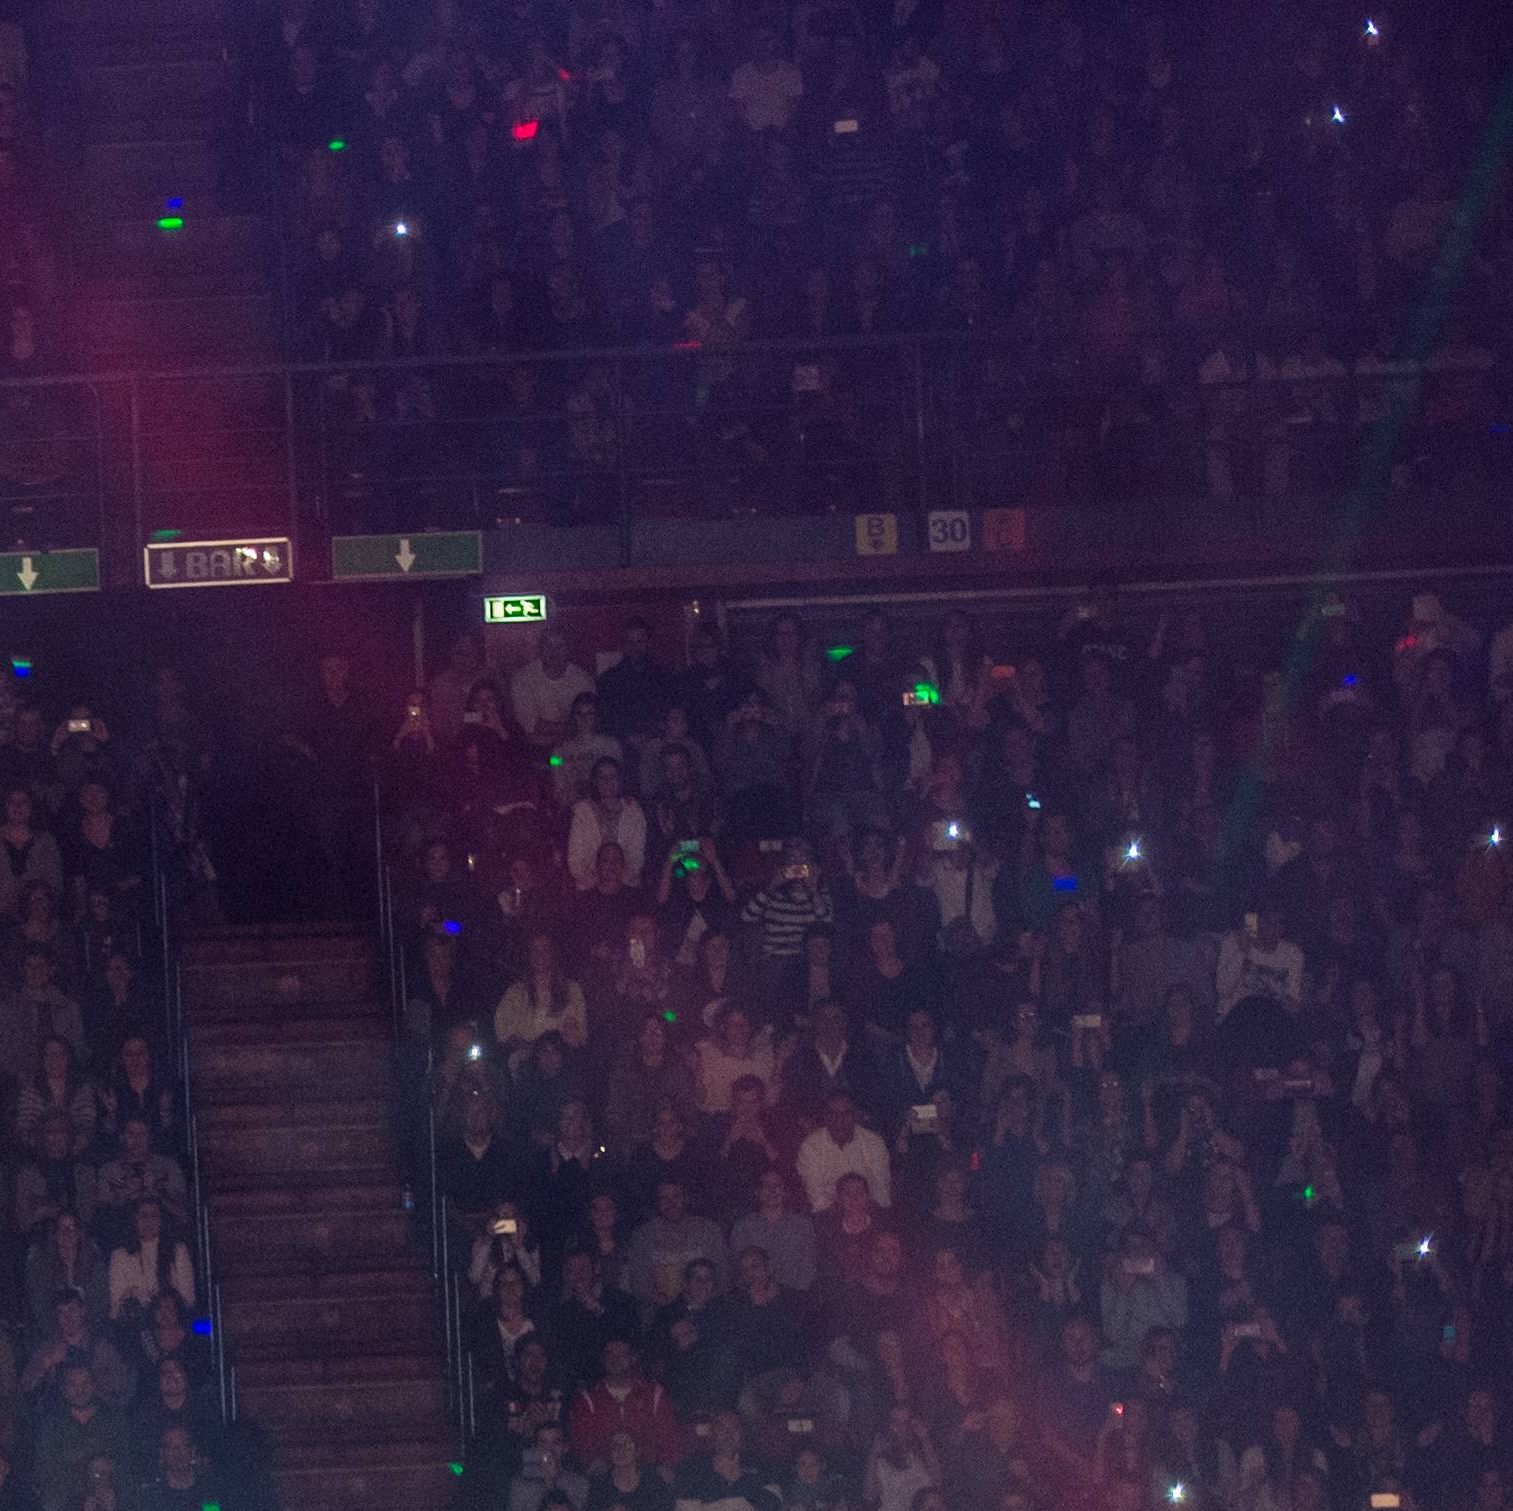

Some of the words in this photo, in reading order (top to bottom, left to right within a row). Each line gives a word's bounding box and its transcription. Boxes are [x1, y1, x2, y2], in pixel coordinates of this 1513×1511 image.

[867, 517, 884, 536] B
[932, 518, 967, 543] 30
[186, 549, 257, 578] BAR
